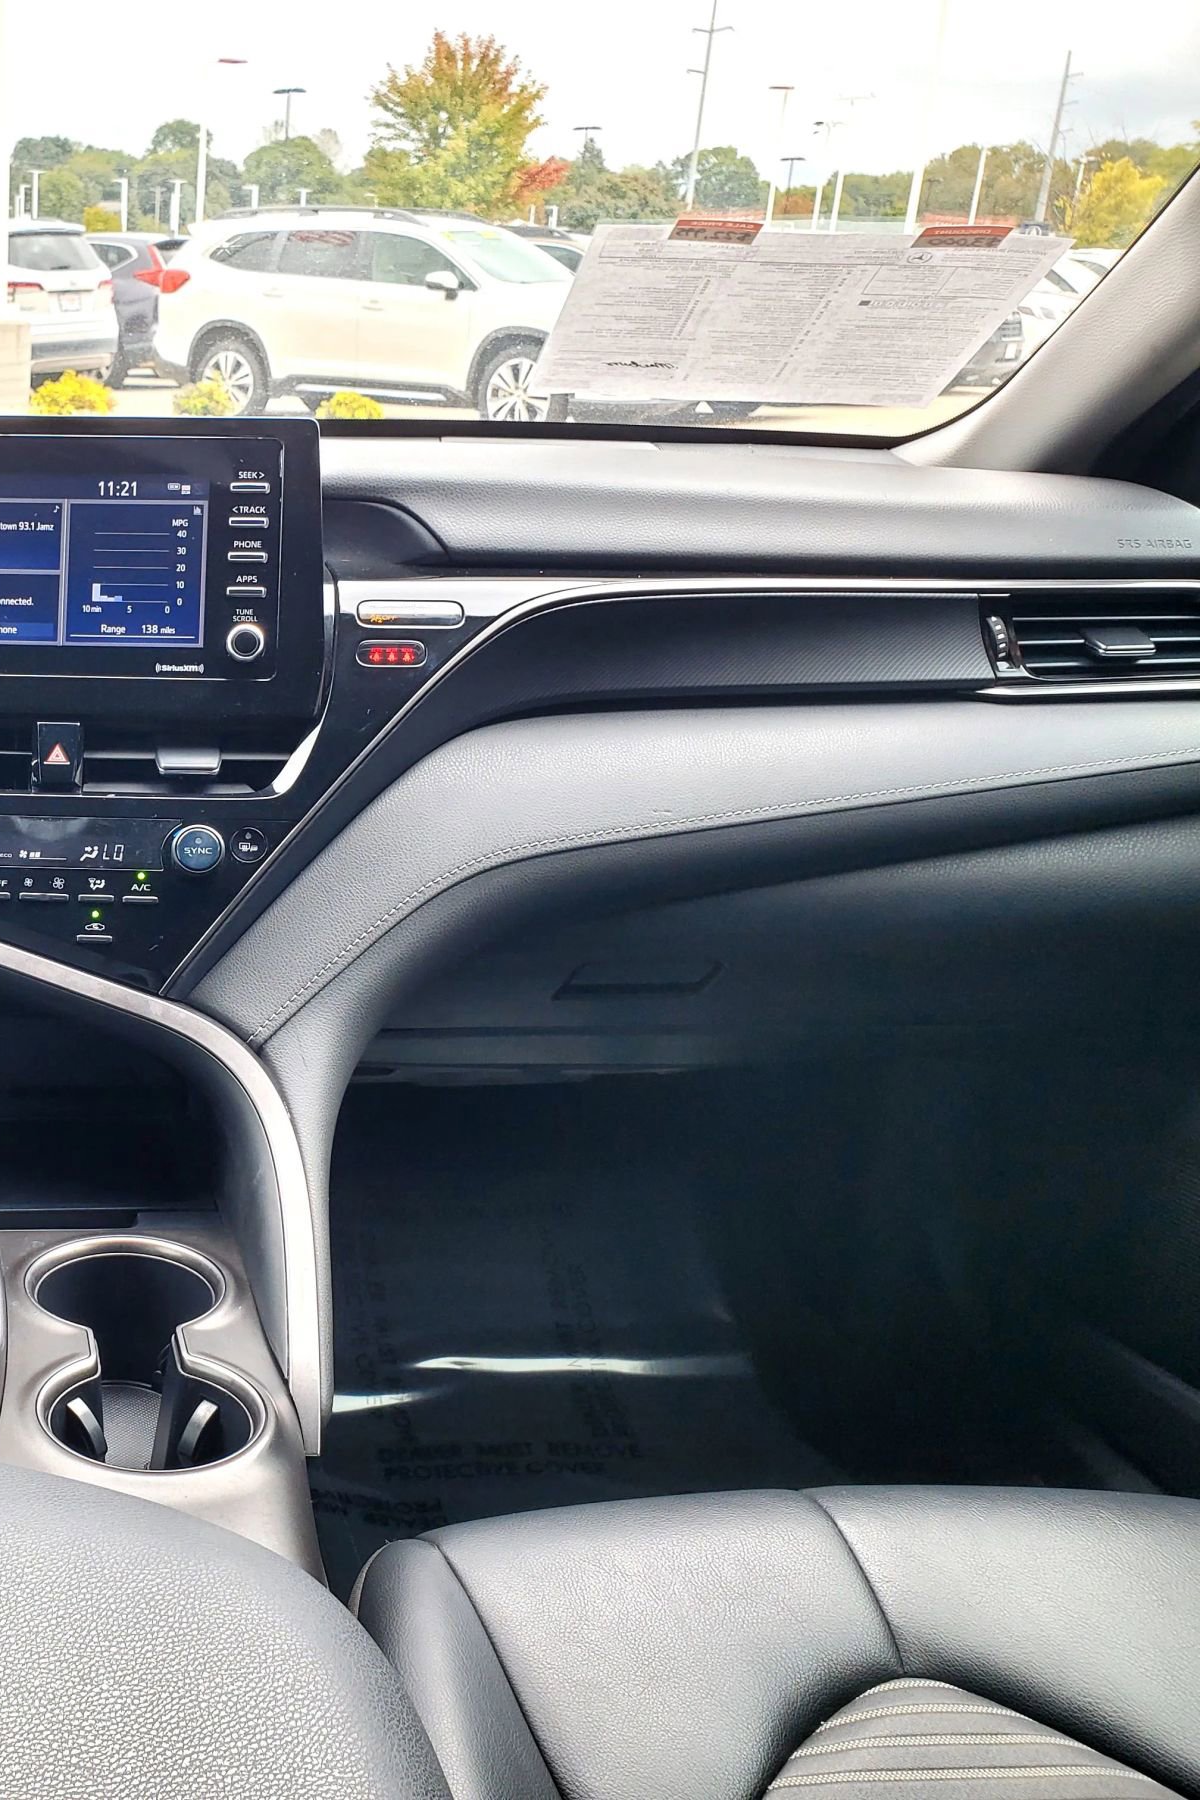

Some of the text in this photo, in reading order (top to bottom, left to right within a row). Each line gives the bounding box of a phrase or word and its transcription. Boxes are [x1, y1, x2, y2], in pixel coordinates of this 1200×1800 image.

[98, 480, 138, 497] 11:21
[238, 506, 266, 514] TRACK
[18, 521, 36, 531] 93.1
[36, 522, 54, 532] Jamz
[171, 518, 189, 527] MPG
[176, 529, 187, 539] 40
[233, 540, 262, 549] PHONE
[1116, 538, 1192, 549] SRS AIRBAG
[176, 546, 187, 555] 30
[176, 563, 186, 572] 20
[235, 575, 258, 583] APPS
[176, 581, 185, 589] 10
[176, 597, 183, 606] 0
[82, 605, 102, 613] 10 min
[127, 605, 133, 614] 5
[164, 606, 170, 614] 0
[235, 608, 254, 616] TUNE
[232, 615, 258, 623] SCROLL
[100, 624, 176, 635] Range 138 miles
[183, 847, 213, 855] SYNC
